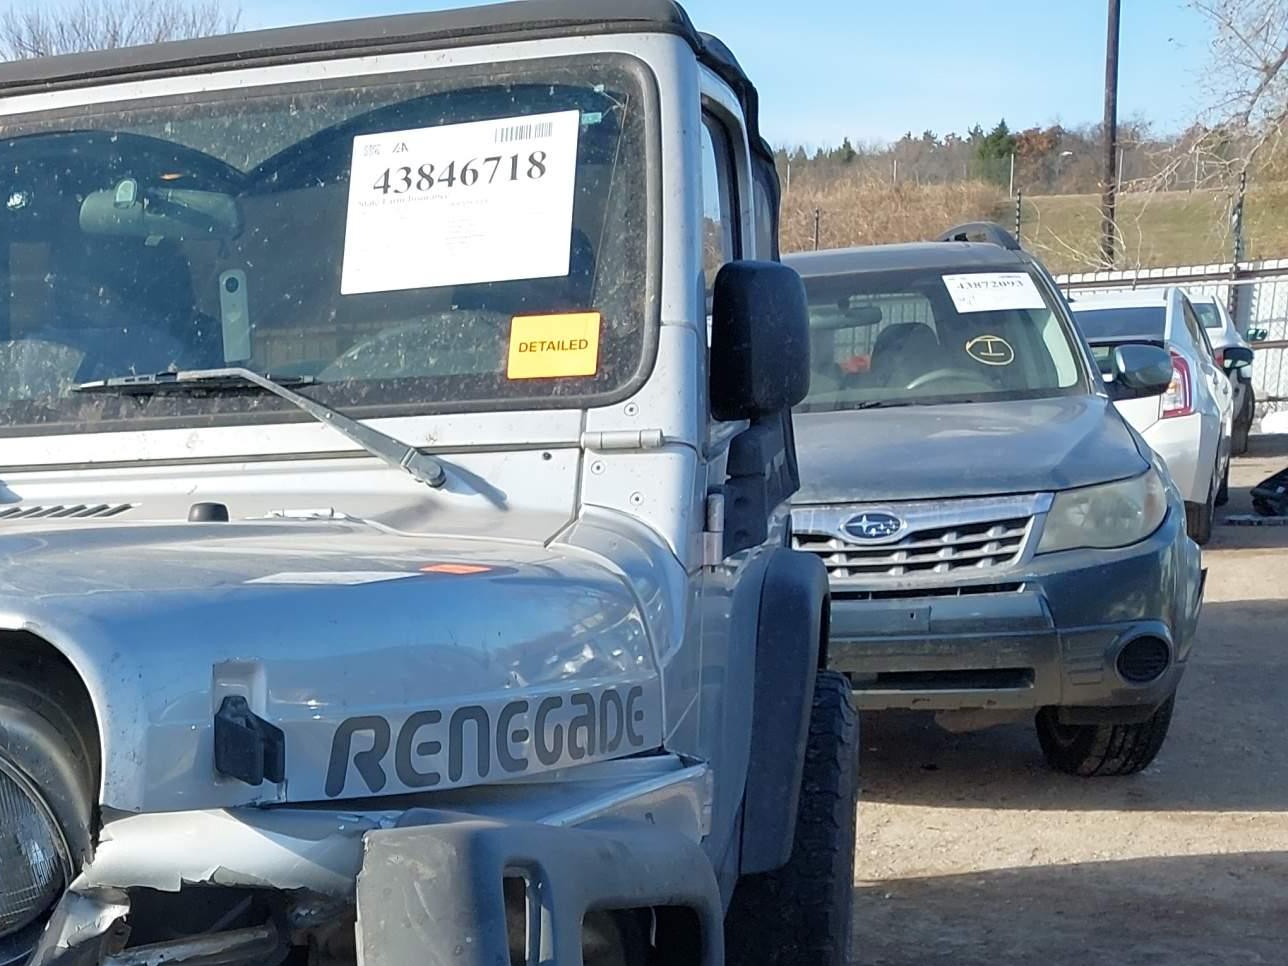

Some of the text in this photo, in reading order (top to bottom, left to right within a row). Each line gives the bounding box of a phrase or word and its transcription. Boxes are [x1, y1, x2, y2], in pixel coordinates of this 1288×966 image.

[373, 150, 547, 195] 43846718
[518, 338, 589, 353] DETAILED
[325, 685, 644, 798] RENEGADE
